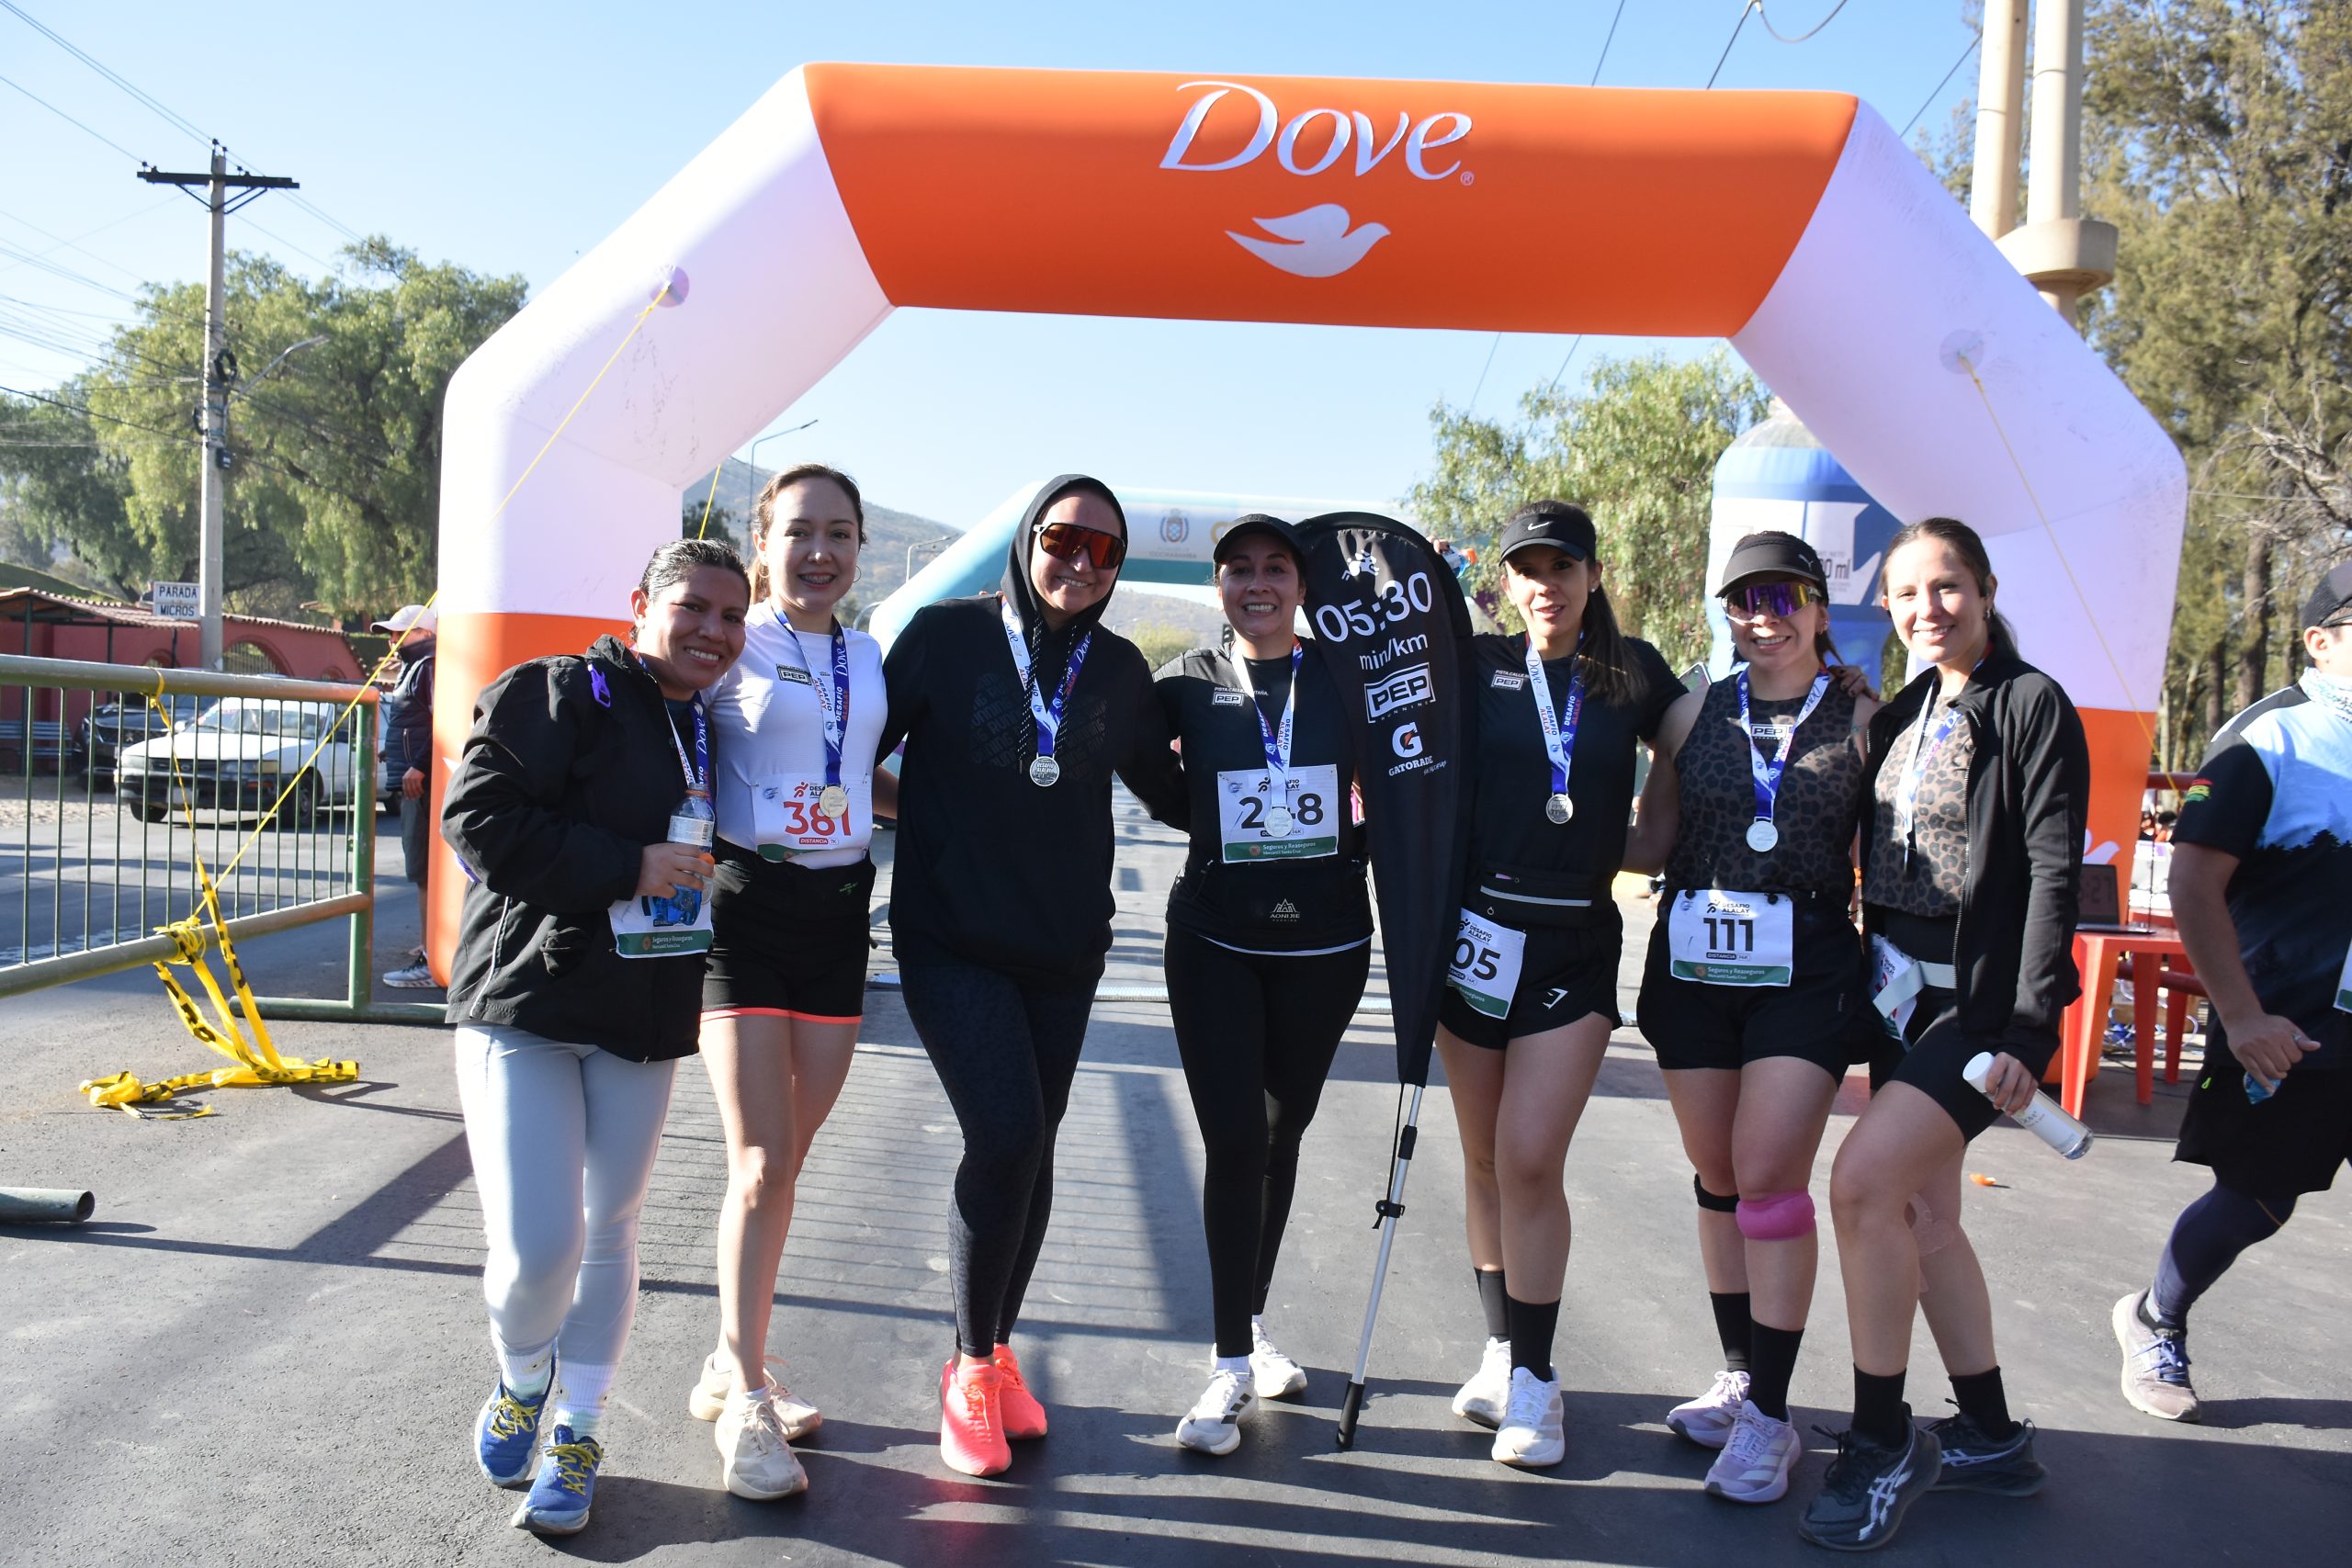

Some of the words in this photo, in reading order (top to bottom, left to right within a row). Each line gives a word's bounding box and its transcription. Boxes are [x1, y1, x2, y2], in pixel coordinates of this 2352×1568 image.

[1159, 80, 1473, 180] Dove
[159, 586, 198, 599] PARADA
[1316, 571, 1432, 642] 05:30
[160, 604, 195, 616] MICROS
[833, 647, 848, 677] Dove
[1074, 634, 1091, 663] Dove
[1359, 633, 1429, 671] min/km
[783, 671, 807, 681] PEP
[1527, 659, 1543, 684] Dove
[1372, 674, 1428, 712] PEP
[695, 717, 707, 755] Dove
[1540, 708, 1552, 736] ALALAY
[1388, 755, 1434, 776] GATORADE
[1467, 931, 1490, 943] ALALAY
[1703, 917, 1753, 952] 111
